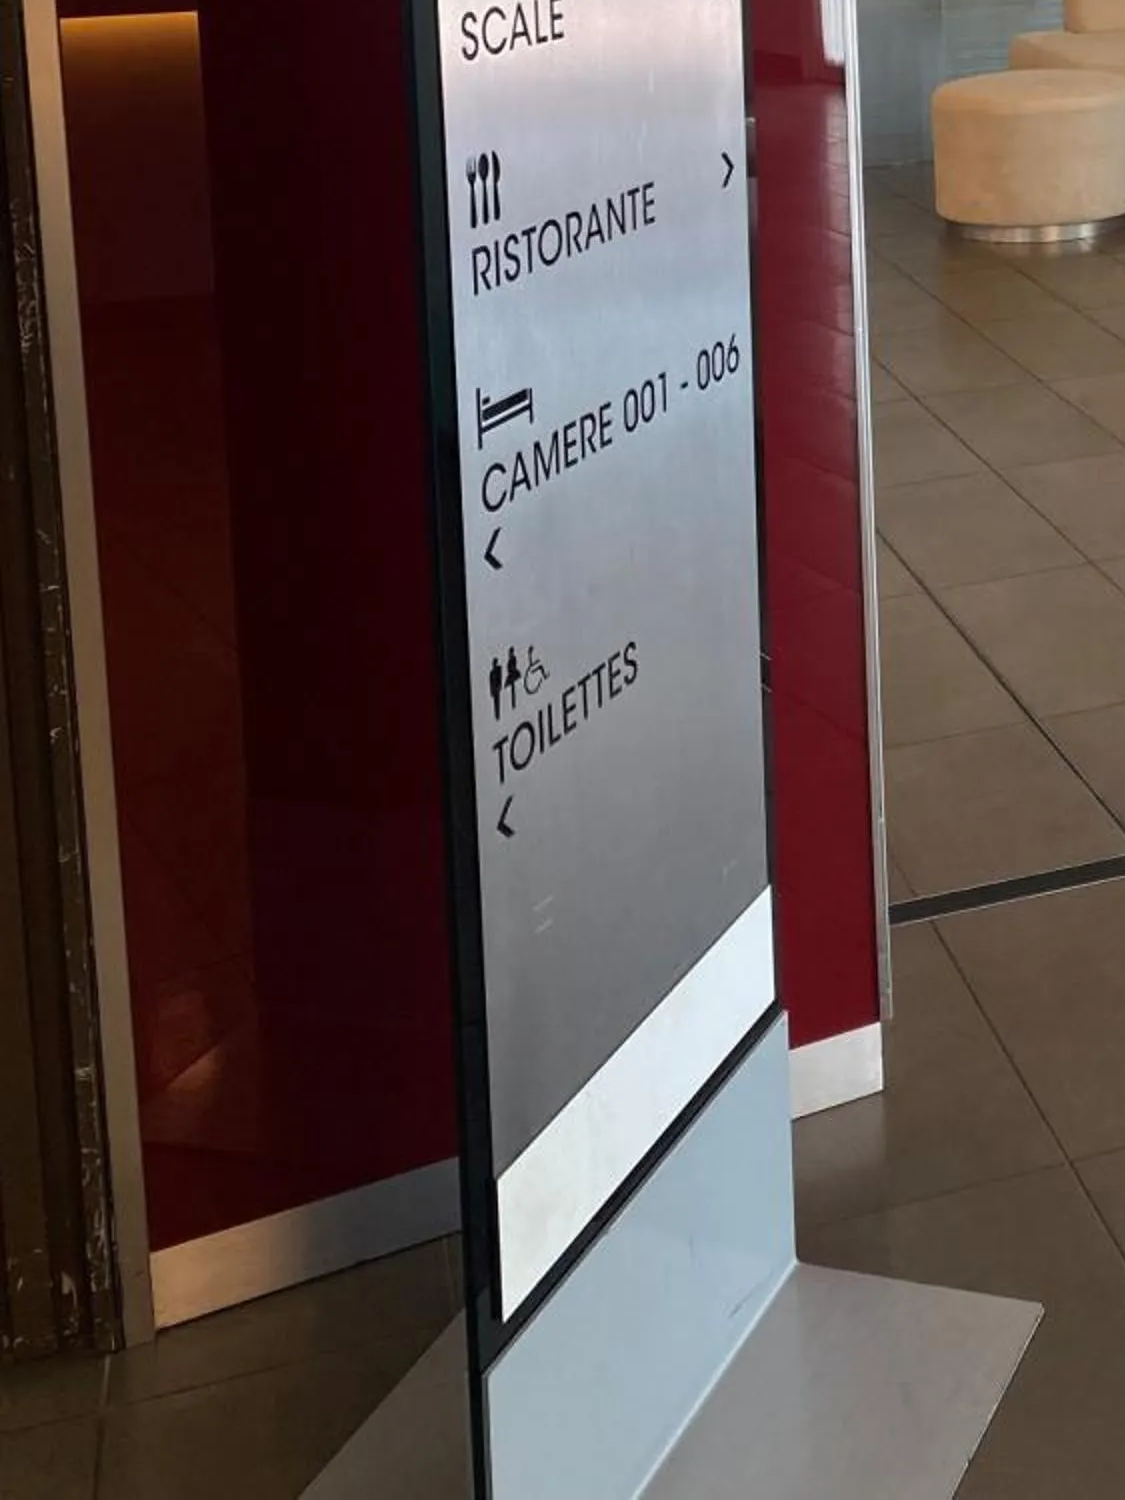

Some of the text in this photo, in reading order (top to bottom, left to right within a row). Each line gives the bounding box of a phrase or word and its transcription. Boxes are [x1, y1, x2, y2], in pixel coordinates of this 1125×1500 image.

[472, 182, 656, 296] RISTORANTE
[481, 402, 613, 512] CAMERE
[623, 371, 668, 433] 001
[696, 333, 740, 390] 006
[492, 641, 639, 784] TOILETTES
